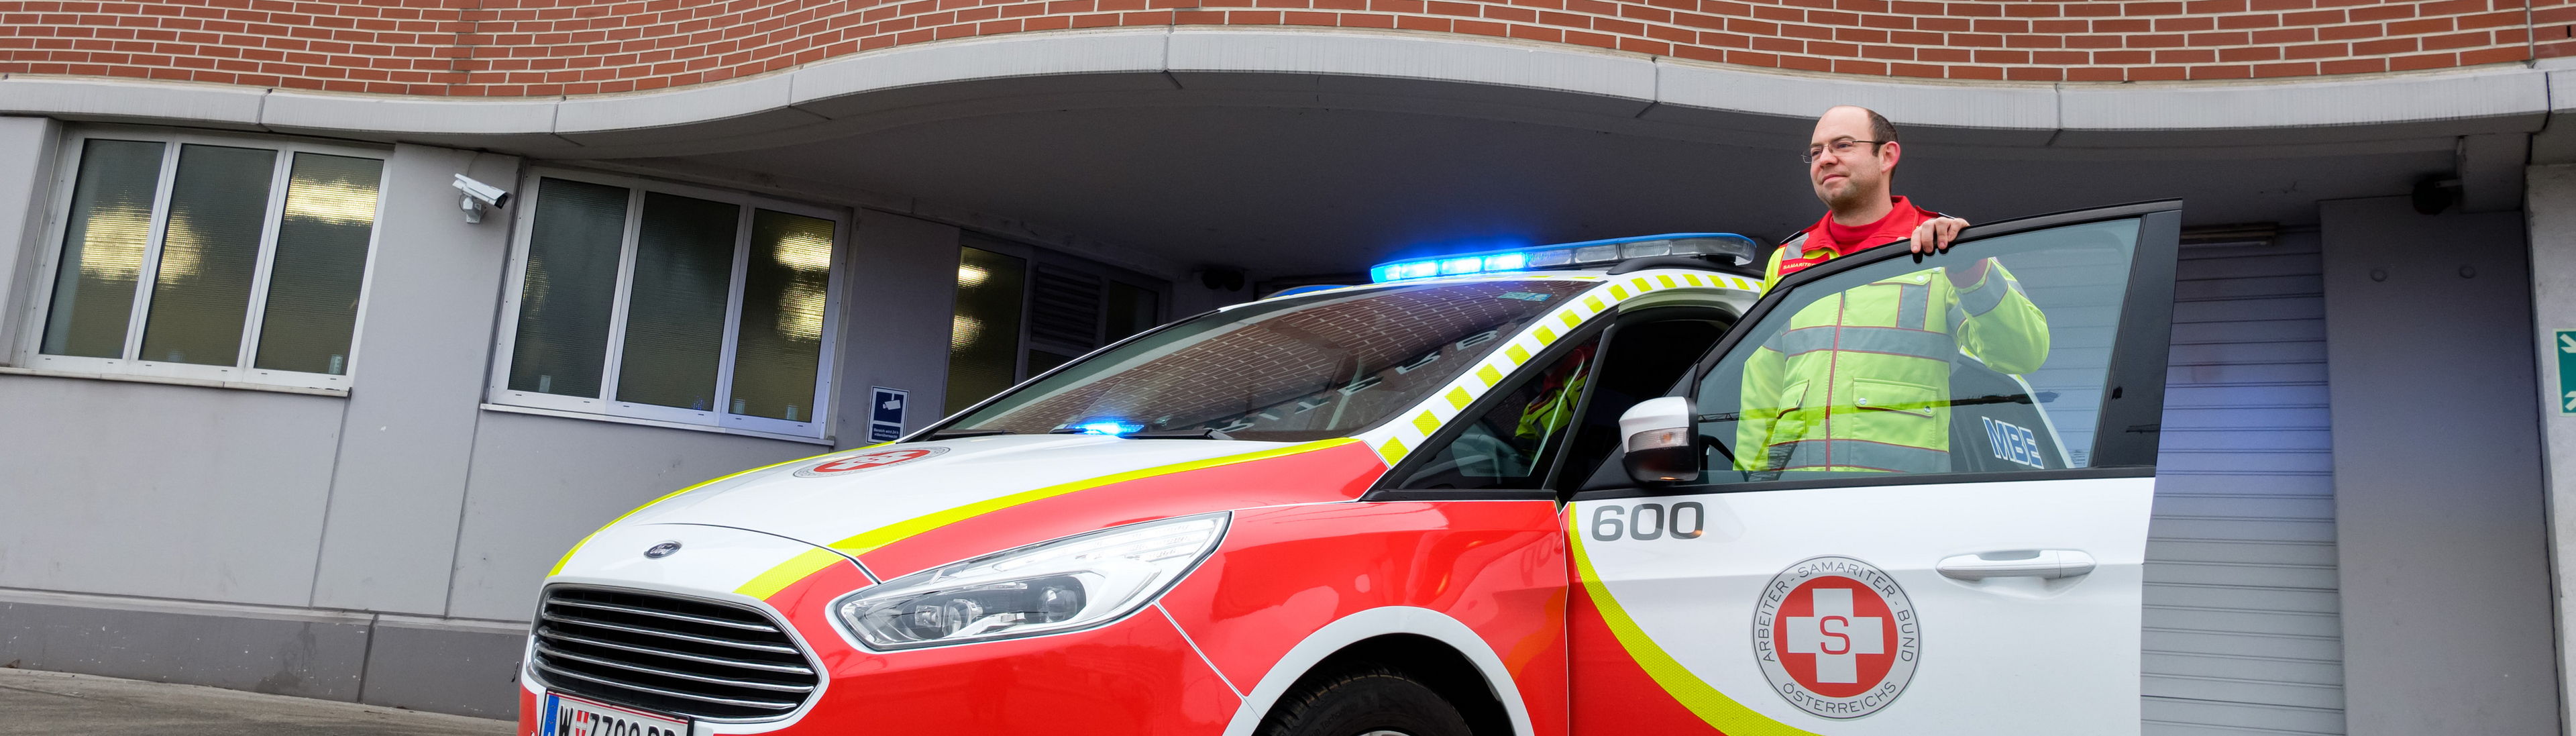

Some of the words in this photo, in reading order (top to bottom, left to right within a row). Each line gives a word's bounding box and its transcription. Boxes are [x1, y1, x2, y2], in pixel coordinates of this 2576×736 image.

[1981, 415, 2045, 470] MBE
[1591, 501, 1705, 542] 600
[1758, 580, 1789, 662] ARBEITER
[1797, 561, 1896, 598] SAMARITER
[1896, 609, 1915, 662] BUND
[1819, 615, 1851, 655] S
[1782, 681, 1897, 715] ÖSTERREICHS
